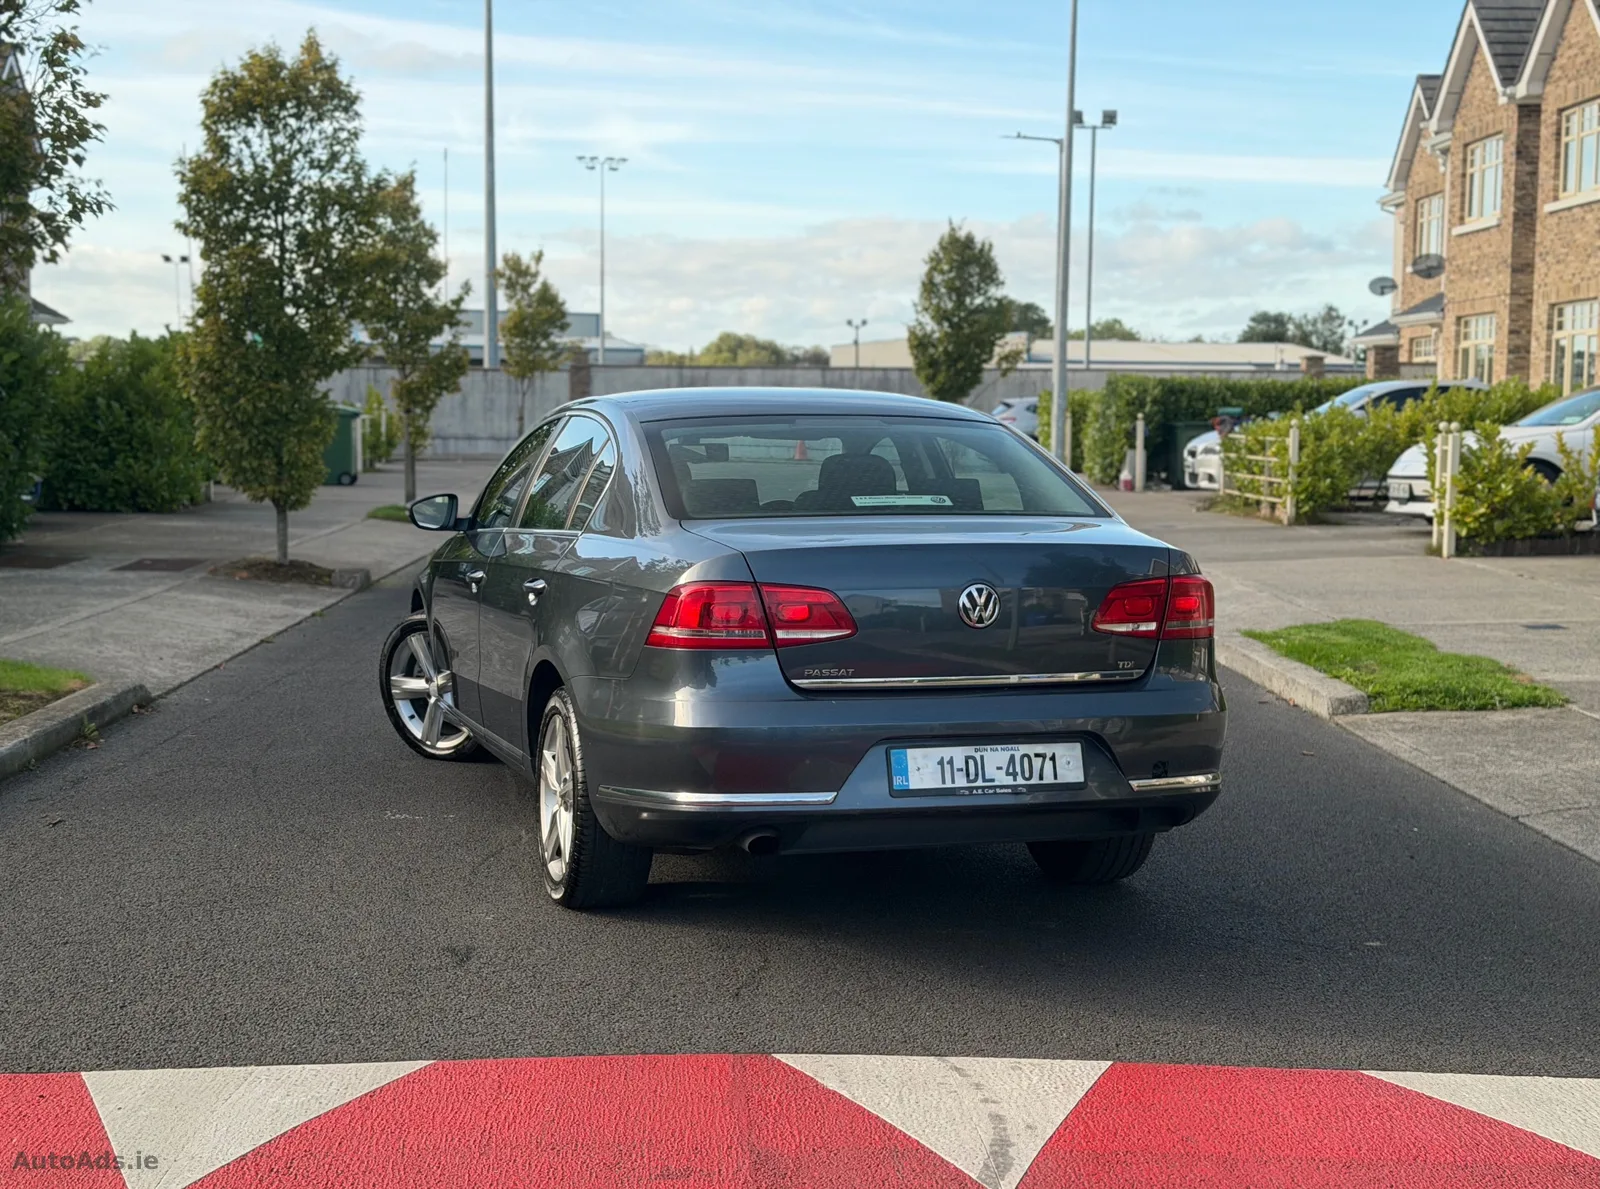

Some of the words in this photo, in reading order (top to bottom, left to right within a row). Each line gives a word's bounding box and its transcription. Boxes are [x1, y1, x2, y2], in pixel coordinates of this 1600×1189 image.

[1117, 660, 1135, 669] TDI
[804, 668, 855, 677] PASSAT
[937, 752, 1058, 785] 11-DL-4071
[893, 775, 909, 786] IRL
